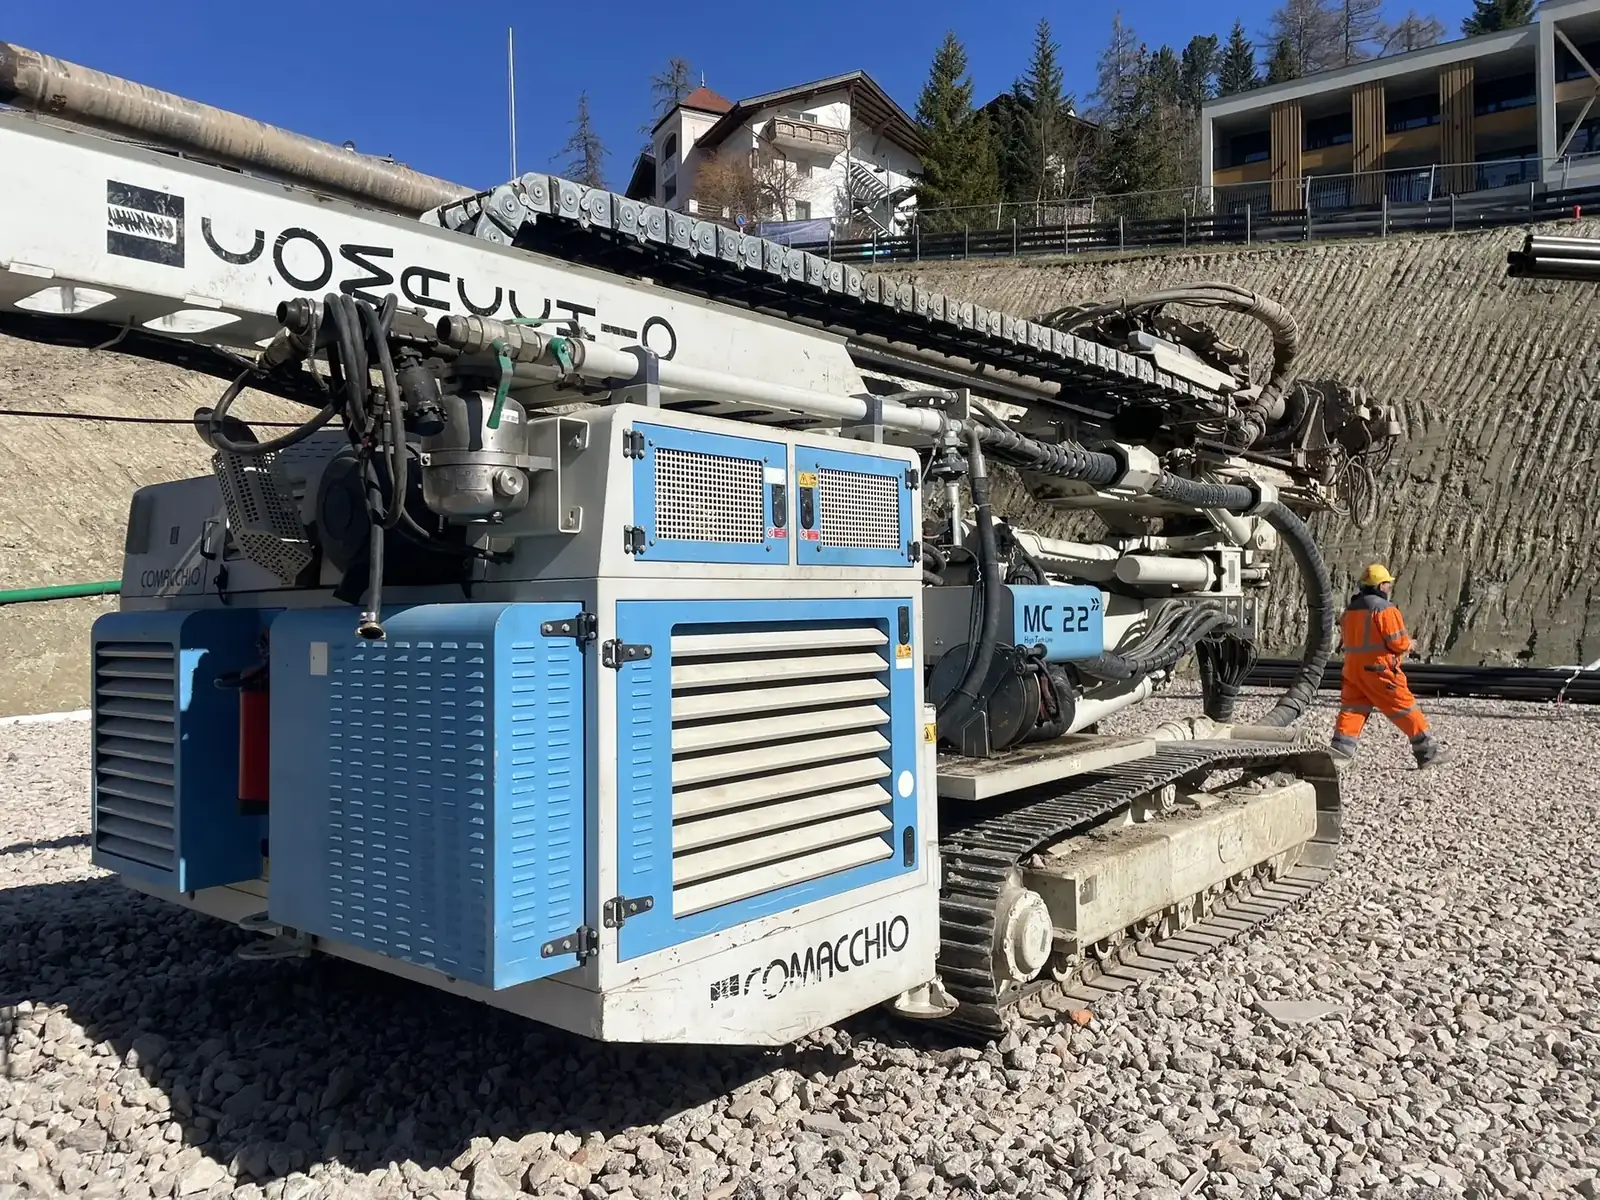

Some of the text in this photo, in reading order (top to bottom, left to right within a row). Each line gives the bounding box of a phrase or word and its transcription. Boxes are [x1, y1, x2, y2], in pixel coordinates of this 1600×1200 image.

[201, 216, 678, 361] COMACCHIO
[141, 567, 201, 588] COMACCHIO
[1024, 605, 1089, 633] MC 22
